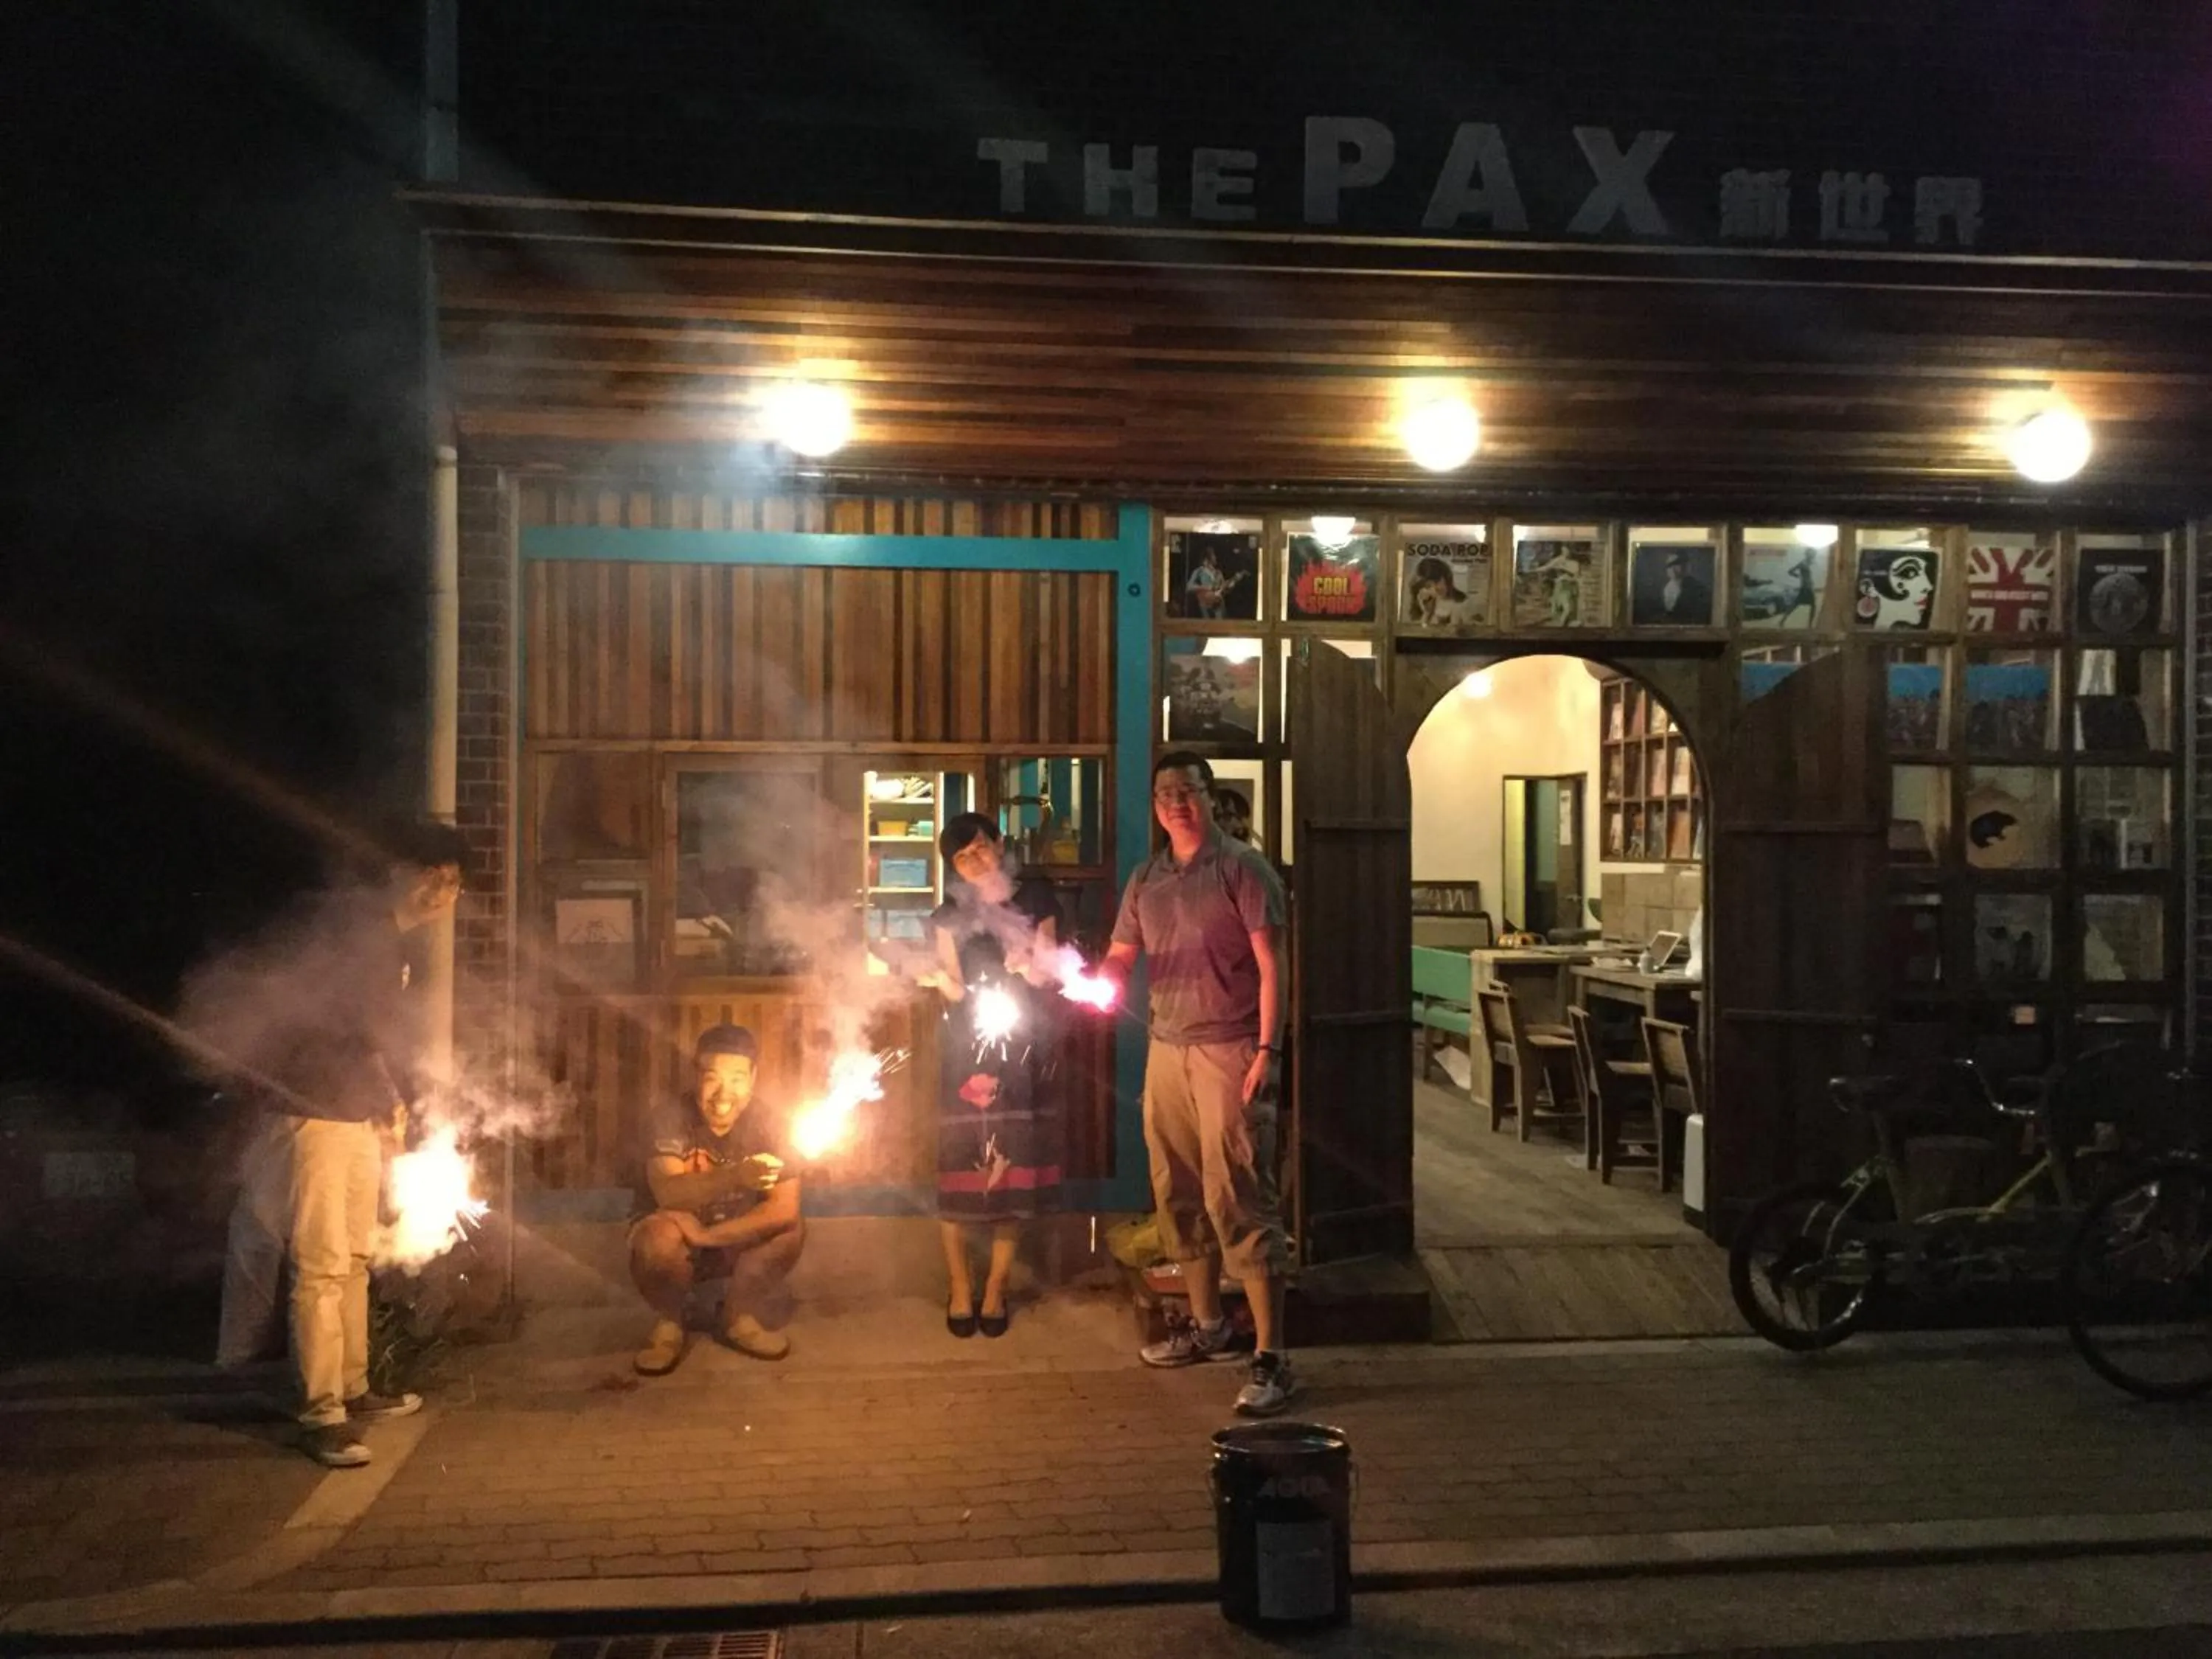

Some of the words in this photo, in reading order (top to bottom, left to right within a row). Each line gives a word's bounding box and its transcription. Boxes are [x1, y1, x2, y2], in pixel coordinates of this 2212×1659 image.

[976, 137, 1257, 220] THE
[1304, 116, 1675, 234] PAX
[1407, 543, 1452, 556] SODA
[1313, 577, 1350, 595] COOL
